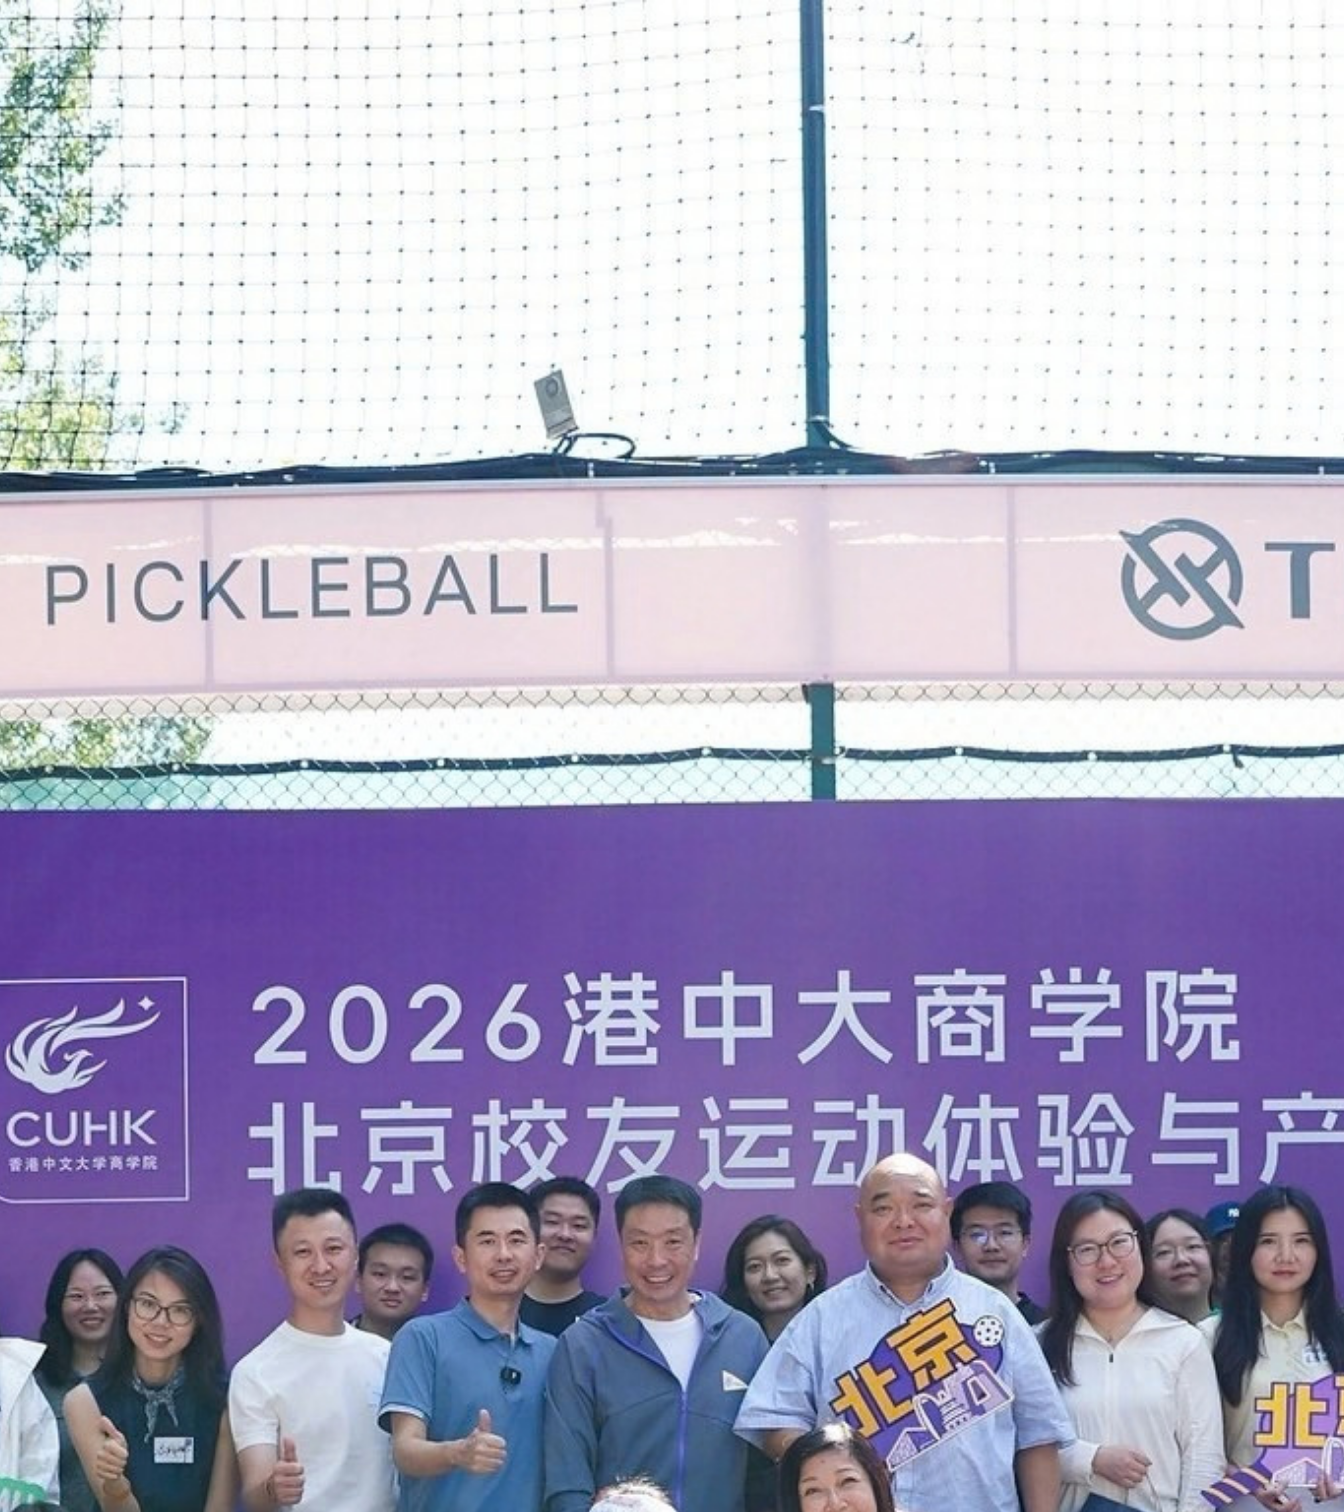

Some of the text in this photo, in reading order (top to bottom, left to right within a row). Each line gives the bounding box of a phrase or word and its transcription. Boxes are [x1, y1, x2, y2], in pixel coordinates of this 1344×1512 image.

[46, 553, 578, 626] PICKLEBALL
[252, 967, 1241, 1066] 2026港中大商学院
[6, 1110, 157, 1147] CUHK
[8, 1155, 159, 1172] 香港中文大学商学院
[830, 1299, 978, 1438] 北京
